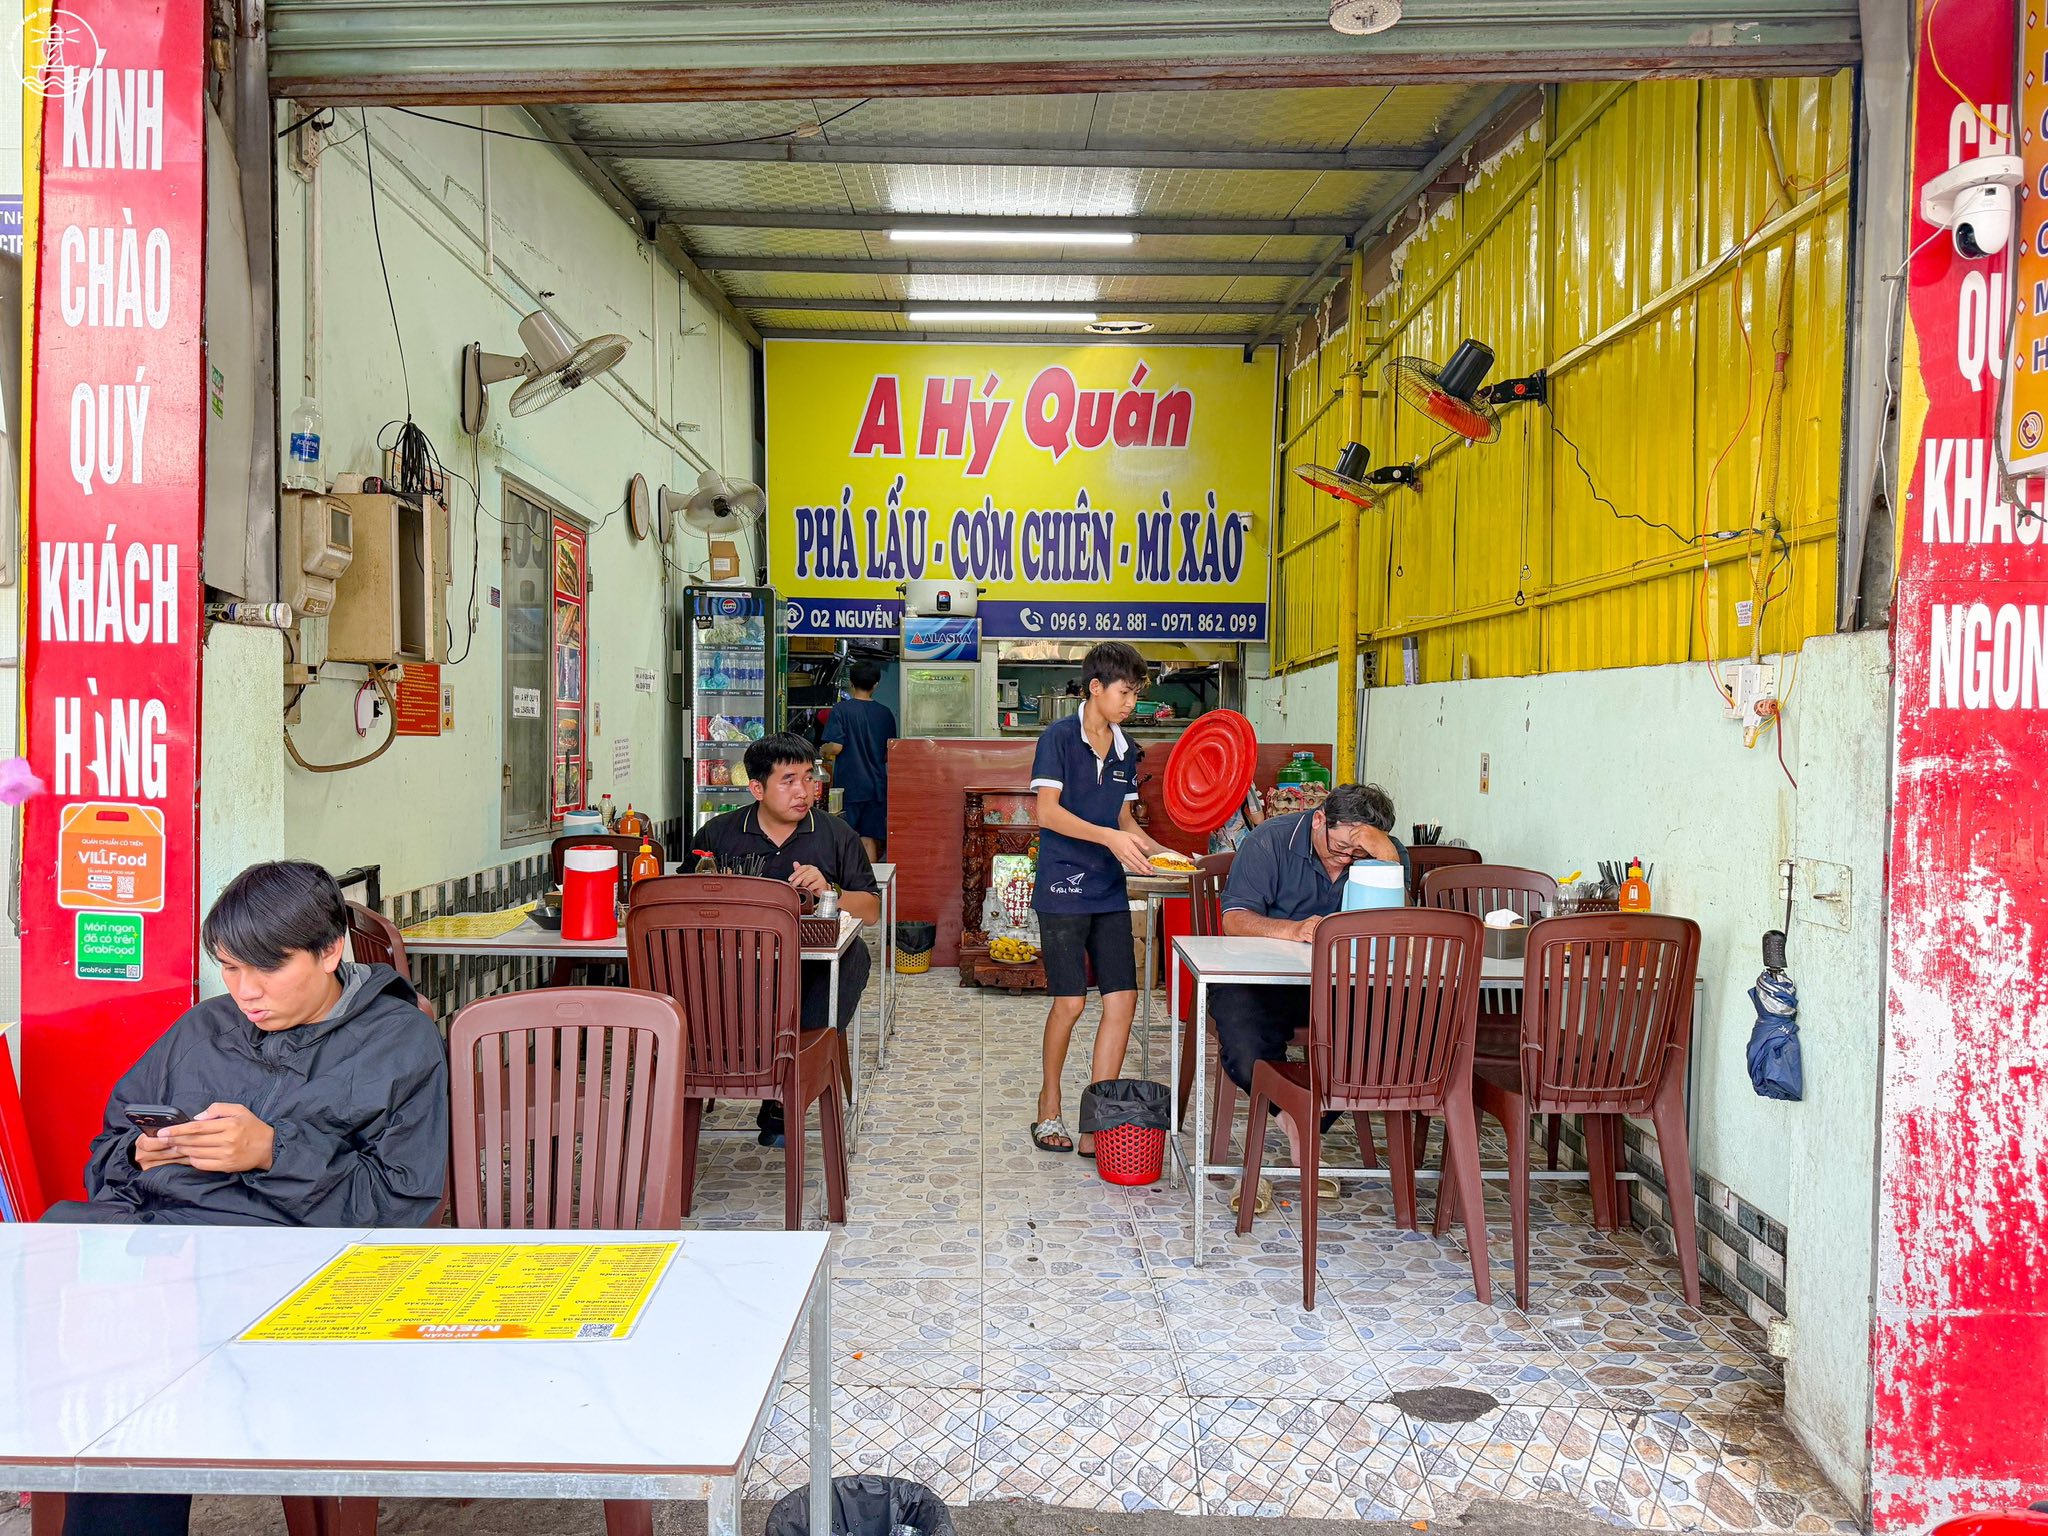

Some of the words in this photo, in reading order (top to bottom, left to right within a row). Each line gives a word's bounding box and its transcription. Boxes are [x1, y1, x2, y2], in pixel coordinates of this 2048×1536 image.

[62, 48, 164, 170] KÍNH
[60, 208, 171, 329] CHÀO
[853, 376, 898, 457] A
[1024, 362, 1193, 460] Quán
[70, 366, 150, 495] QUÝ
[796, 488, 858, 579] PHÁ
[866, 476, 926, 579] LẤU
[952, 496, 1014, 581] CƠM
[1022, 489, 1114, 582] CHIÊN
[1137, 491, 1171, 581] MÌ
[1179, 491, 1242, 583] XÀO
[40, 524, 178, 643] KHÁCH
[810, 610, 830, 628] 02
[835, 604, 893, 629] NGUYỄN
[1050, 612, 1091, 630] 0969.
[1095, 613, 1123, 631] 862.
[1127, 613, 1147, 631] 881
[1161, 614, 1193, 631] 0971.
[1198, 614, 1225, 632] 862.
[1229, 614, 1257, 632] 099
[923, 632, 971, 644] ALASKA
[84, 921, 107, 931] Món
[108, 925, 135, 934] ngon
[84, 933, 98, 943] đã
[100, 934, 112, 943] có
[113, 935, 135, 944] trên
[83, 944, 135, 955] GrabFood
[80, 966, 111, 974] GrabFood
[416, 1324, 502, 1332] MENU
